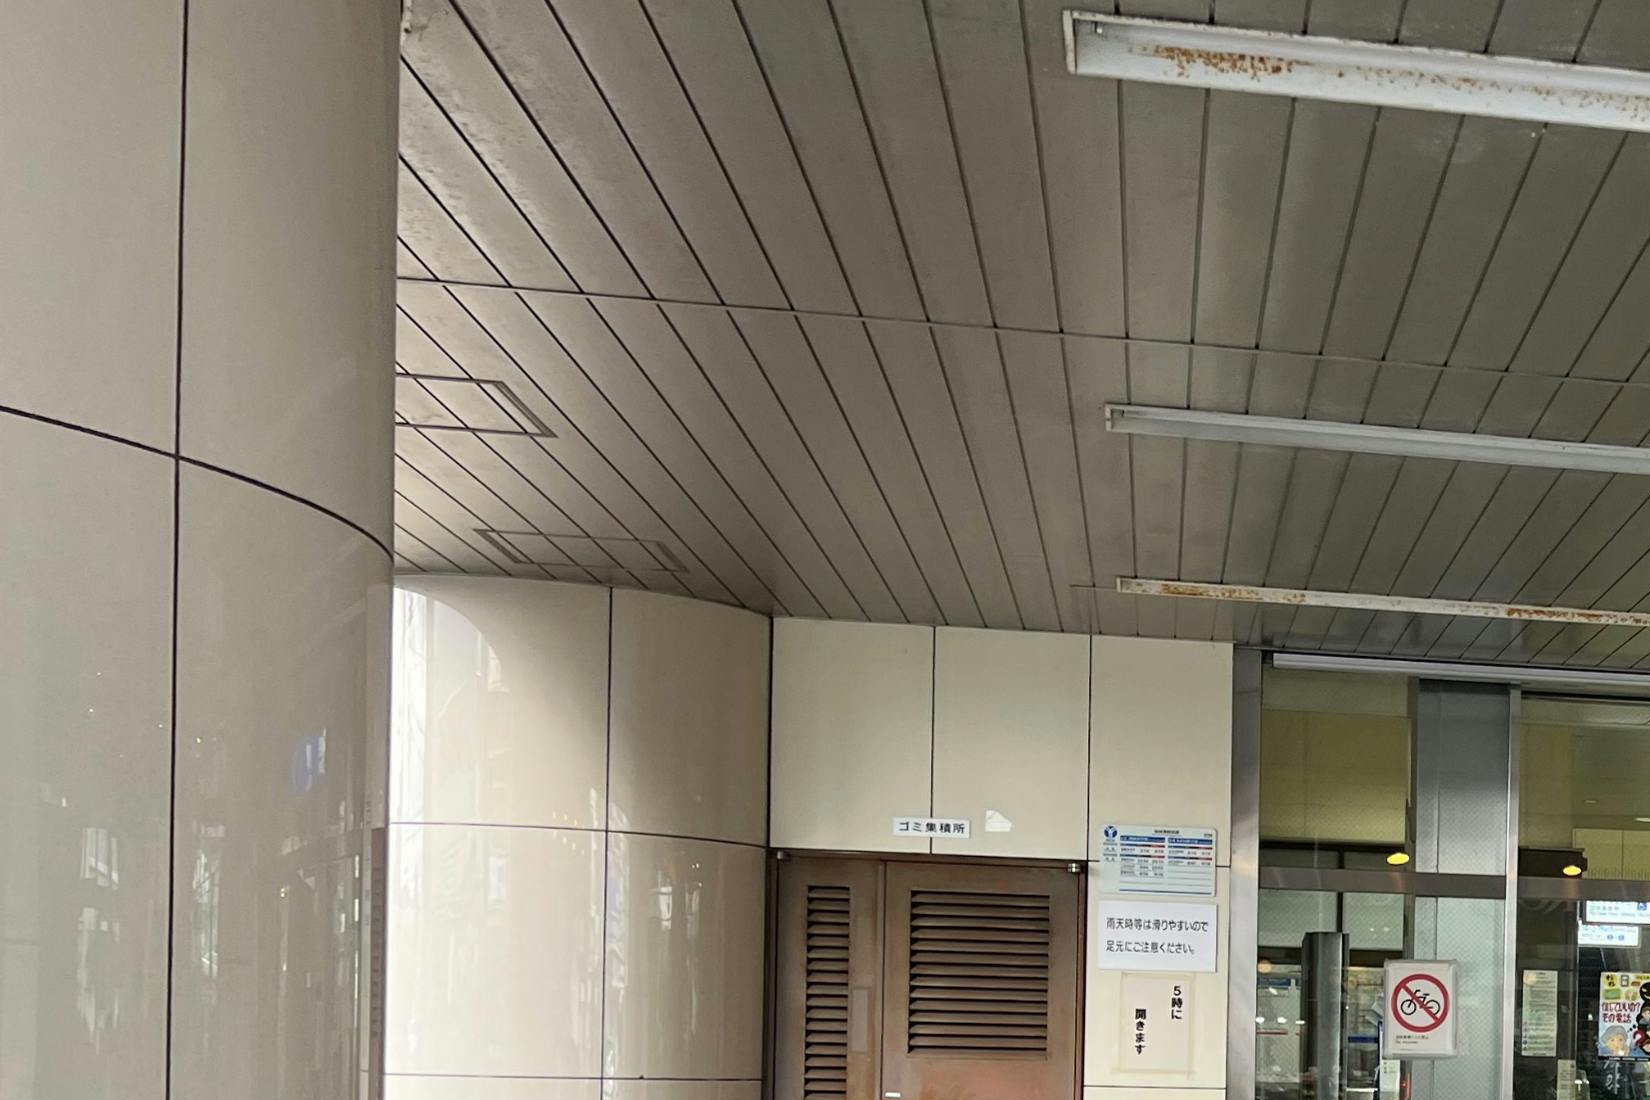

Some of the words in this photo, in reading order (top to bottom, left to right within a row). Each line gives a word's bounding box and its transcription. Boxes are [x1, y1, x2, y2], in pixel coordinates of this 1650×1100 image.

[899, 822, 965, 834] ゴミ集積所
[1106, 940, 1195, 955] 足元にご注意ください。
[1171, 985, 1183, 1020] 5時に
[1135, 1008, 1147, 1055] 開きます
